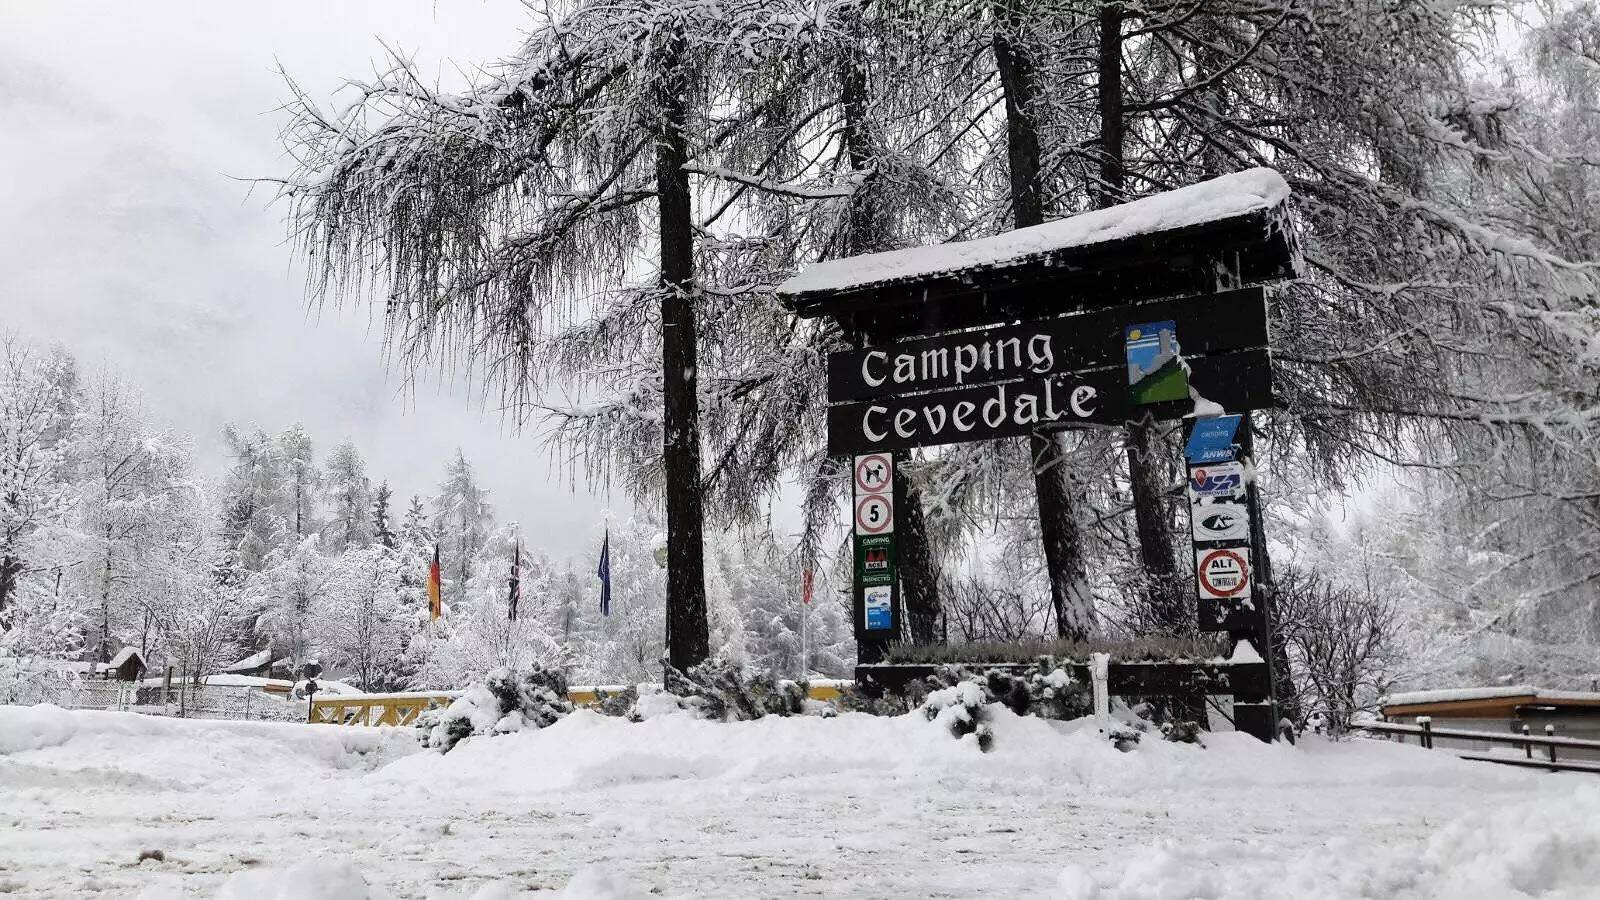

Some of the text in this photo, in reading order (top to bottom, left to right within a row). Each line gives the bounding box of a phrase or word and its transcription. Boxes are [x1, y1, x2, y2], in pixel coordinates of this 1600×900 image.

[862, 332, 1054, 387] Camping
[862, 377, 1098, 442] Cevedale
[869, 504, 880, 523] 5
[862, 536, 890, 546] CAMPING
[1211, 558, 1233, 569] ALT
